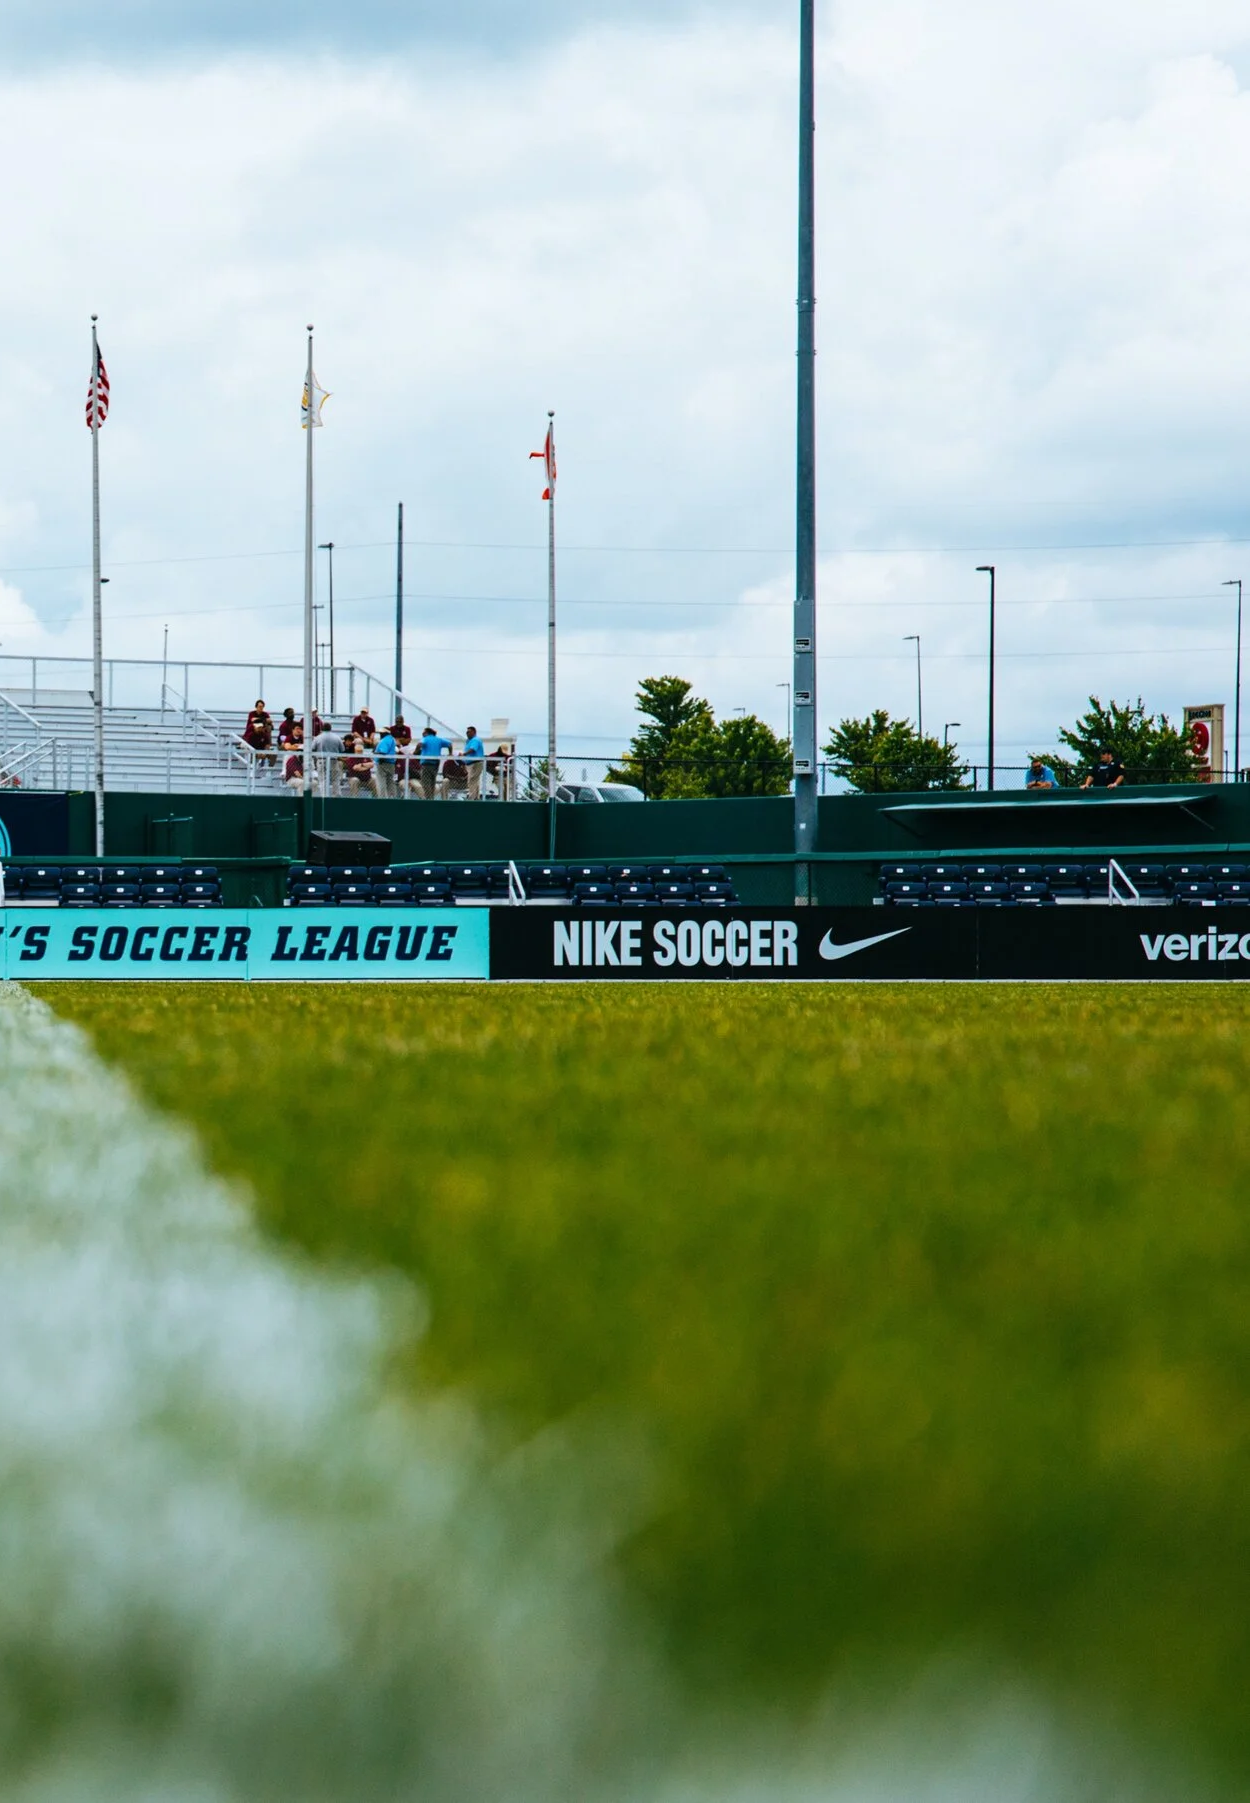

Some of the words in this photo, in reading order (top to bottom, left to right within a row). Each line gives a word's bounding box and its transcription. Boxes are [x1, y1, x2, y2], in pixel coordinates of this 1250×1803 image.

[67, 926, 252, 962] SOCCER
[270, 926, 459, 961] LEAGUE
[553, 921, 642, 966] NIKE
[653, 919, 798, 967] SOCCER
